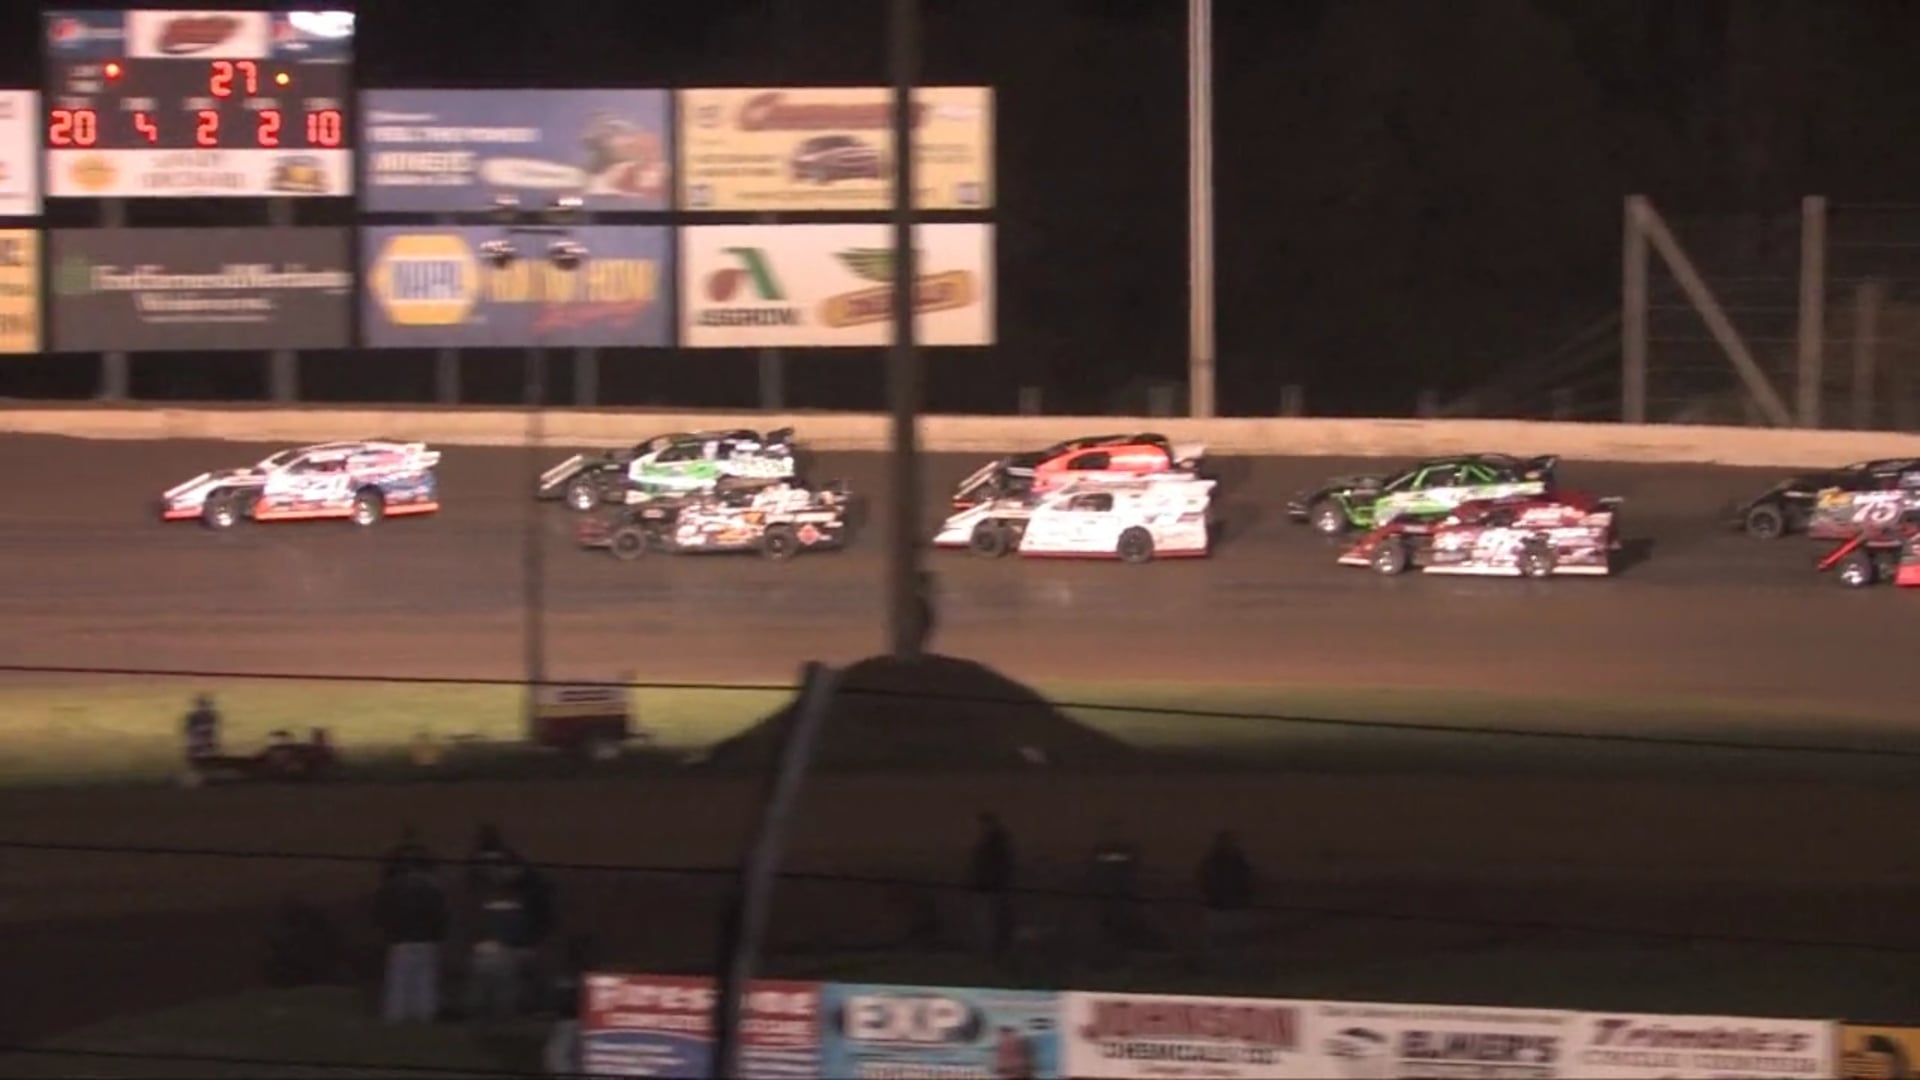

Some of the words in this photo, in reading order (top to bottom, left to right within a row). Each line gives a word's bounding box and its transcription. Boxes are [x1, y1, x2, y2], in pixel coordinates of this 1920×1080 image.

[210, 60, 257, 96] 27
[50, 110, 97, 146] 20
[134, 112, 157, 143] 4
[196, 110, 219, 146] 2
[257, 110, 281, 146] 2
[306, 110, 341, 146] 10
[842, 995, 967, 1044] EXP
[1080, 999, 1299, 1049] JOHNSON
